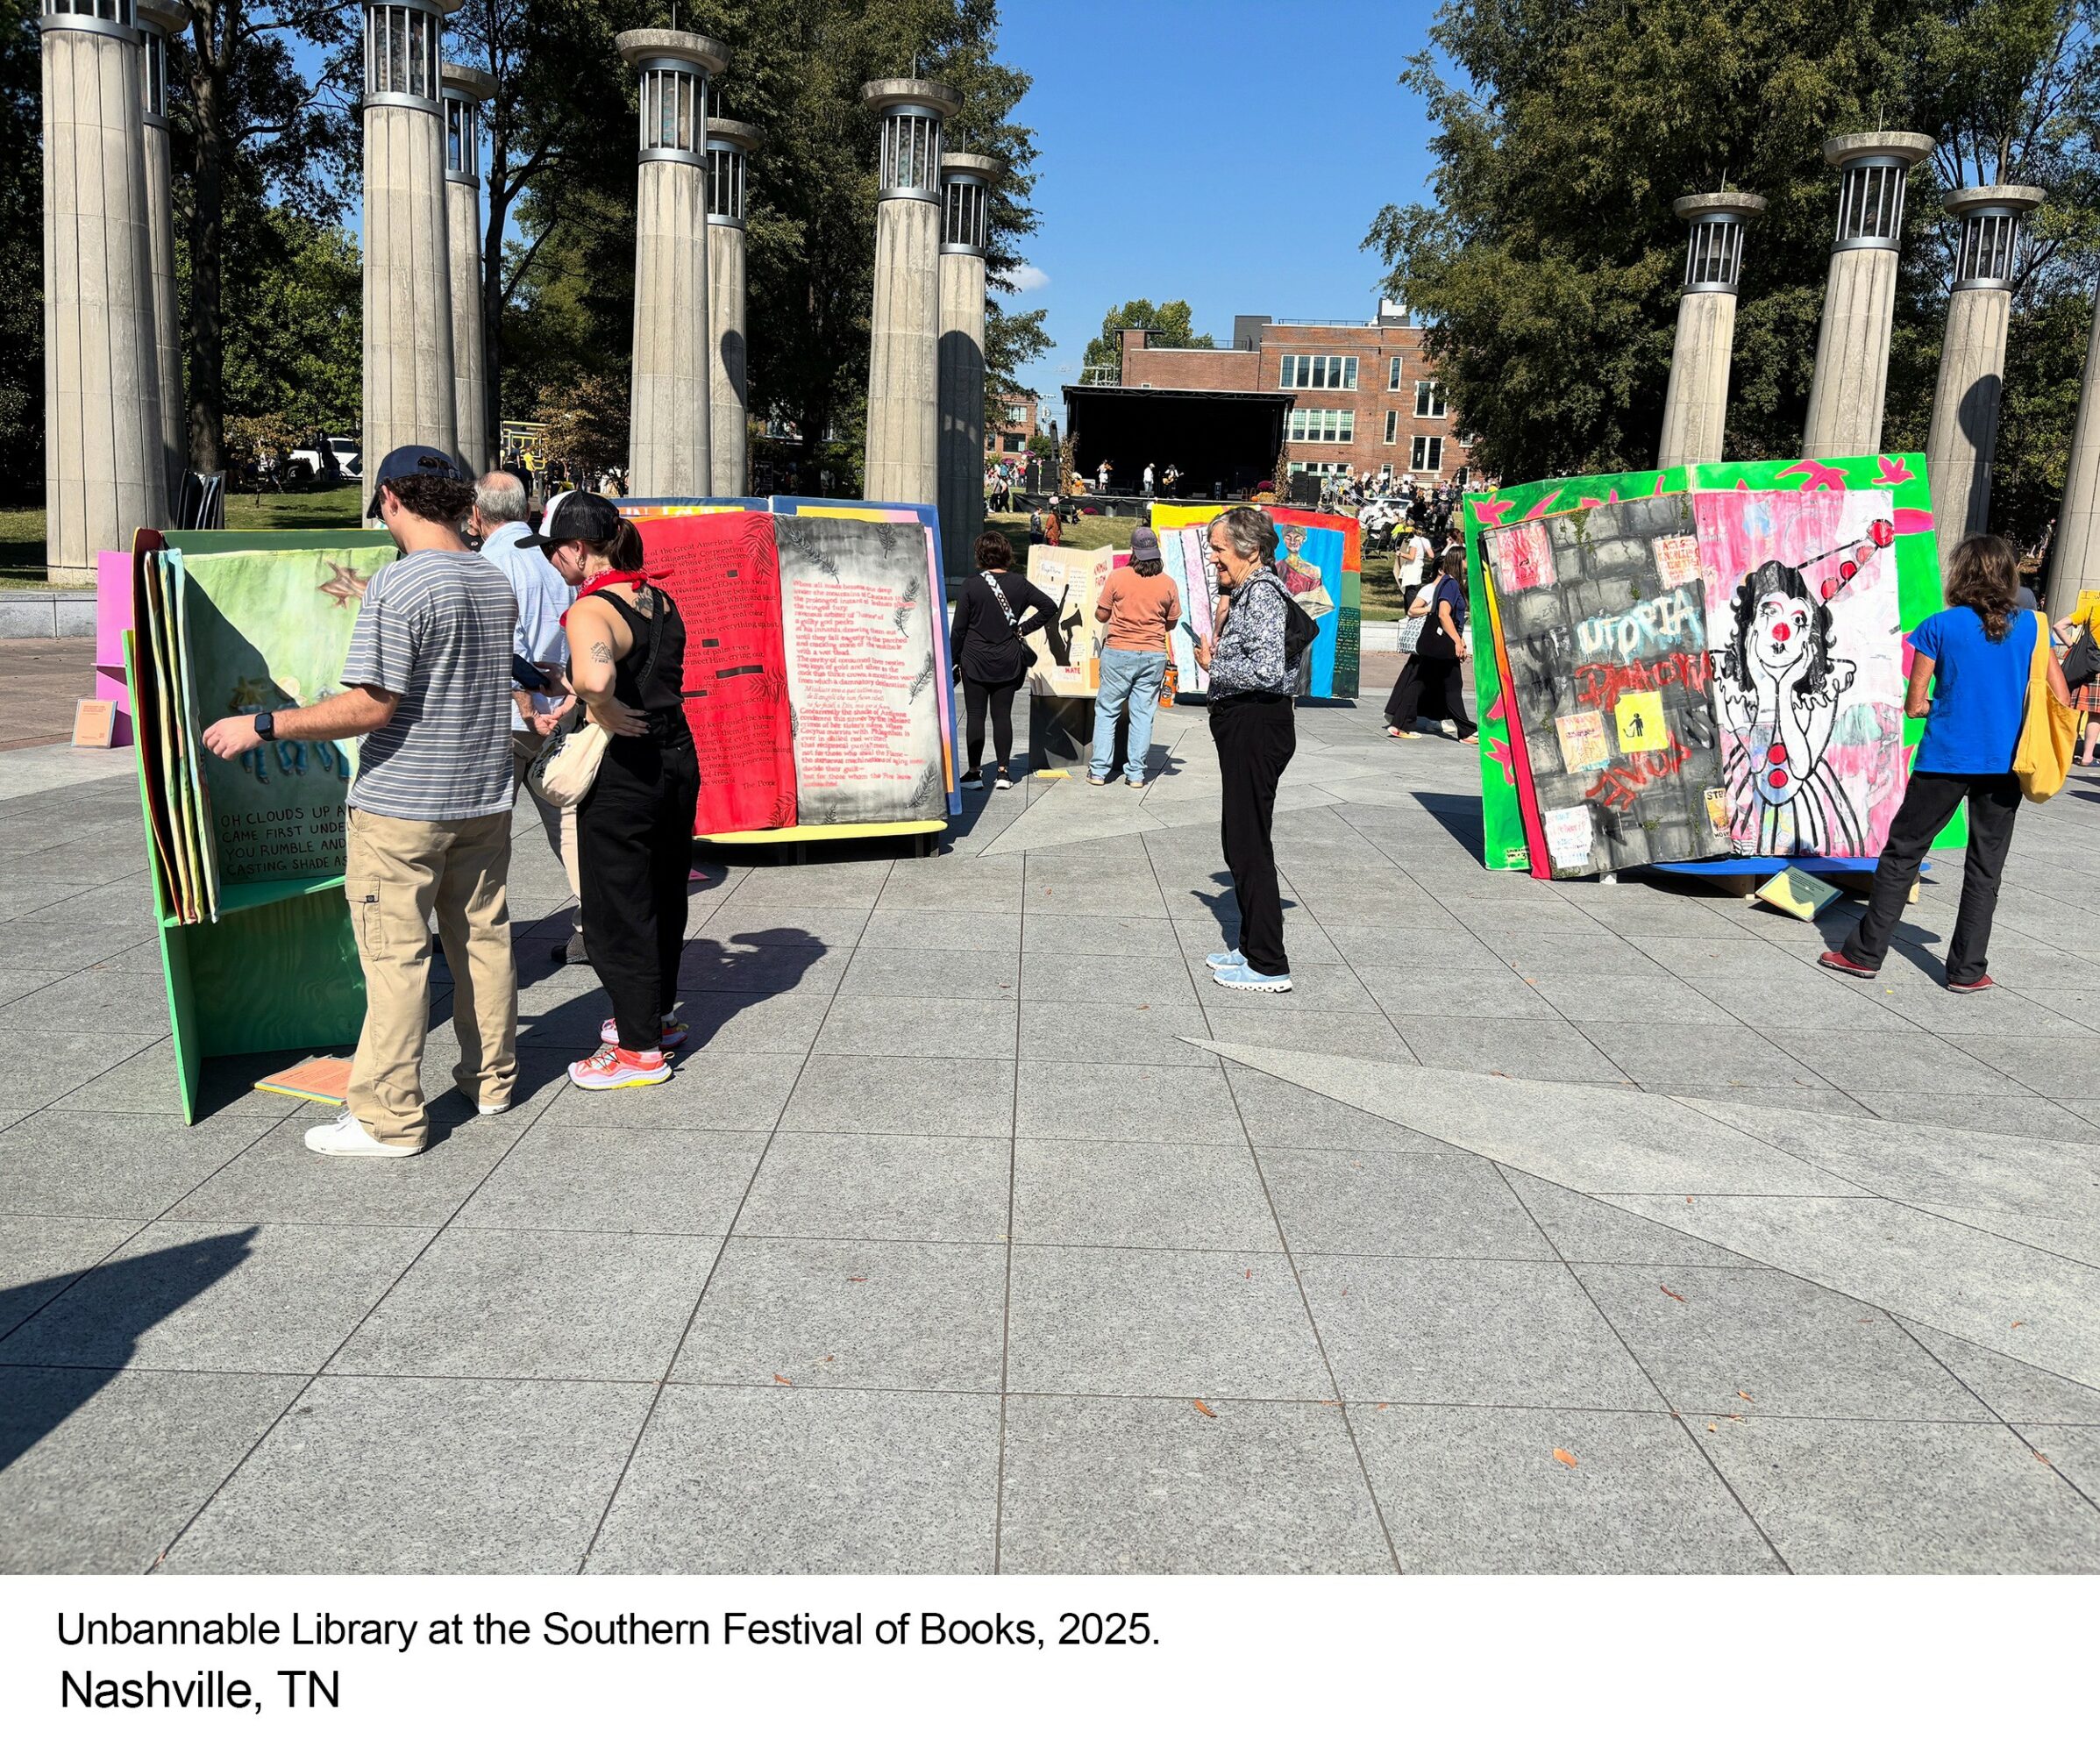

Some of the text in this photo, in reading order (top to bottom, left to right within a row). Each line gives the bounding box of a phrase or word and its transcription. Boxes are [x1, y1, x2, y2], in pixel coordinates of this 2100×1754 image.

[1577, 590, 1704, 656] UTOPIA
[221, 815, 240, 828] OH
[247, 808, 303, 824] CLOUDS
[313, 806, 330, 818] UP
[223, 822, 345, 843] CAME FIRST UNDE
[226, 838, 345, 860] YOU RUMBLE AND
[227, 860, 287, 875] CASTING
[293, 857, 330, 869] SHADE
